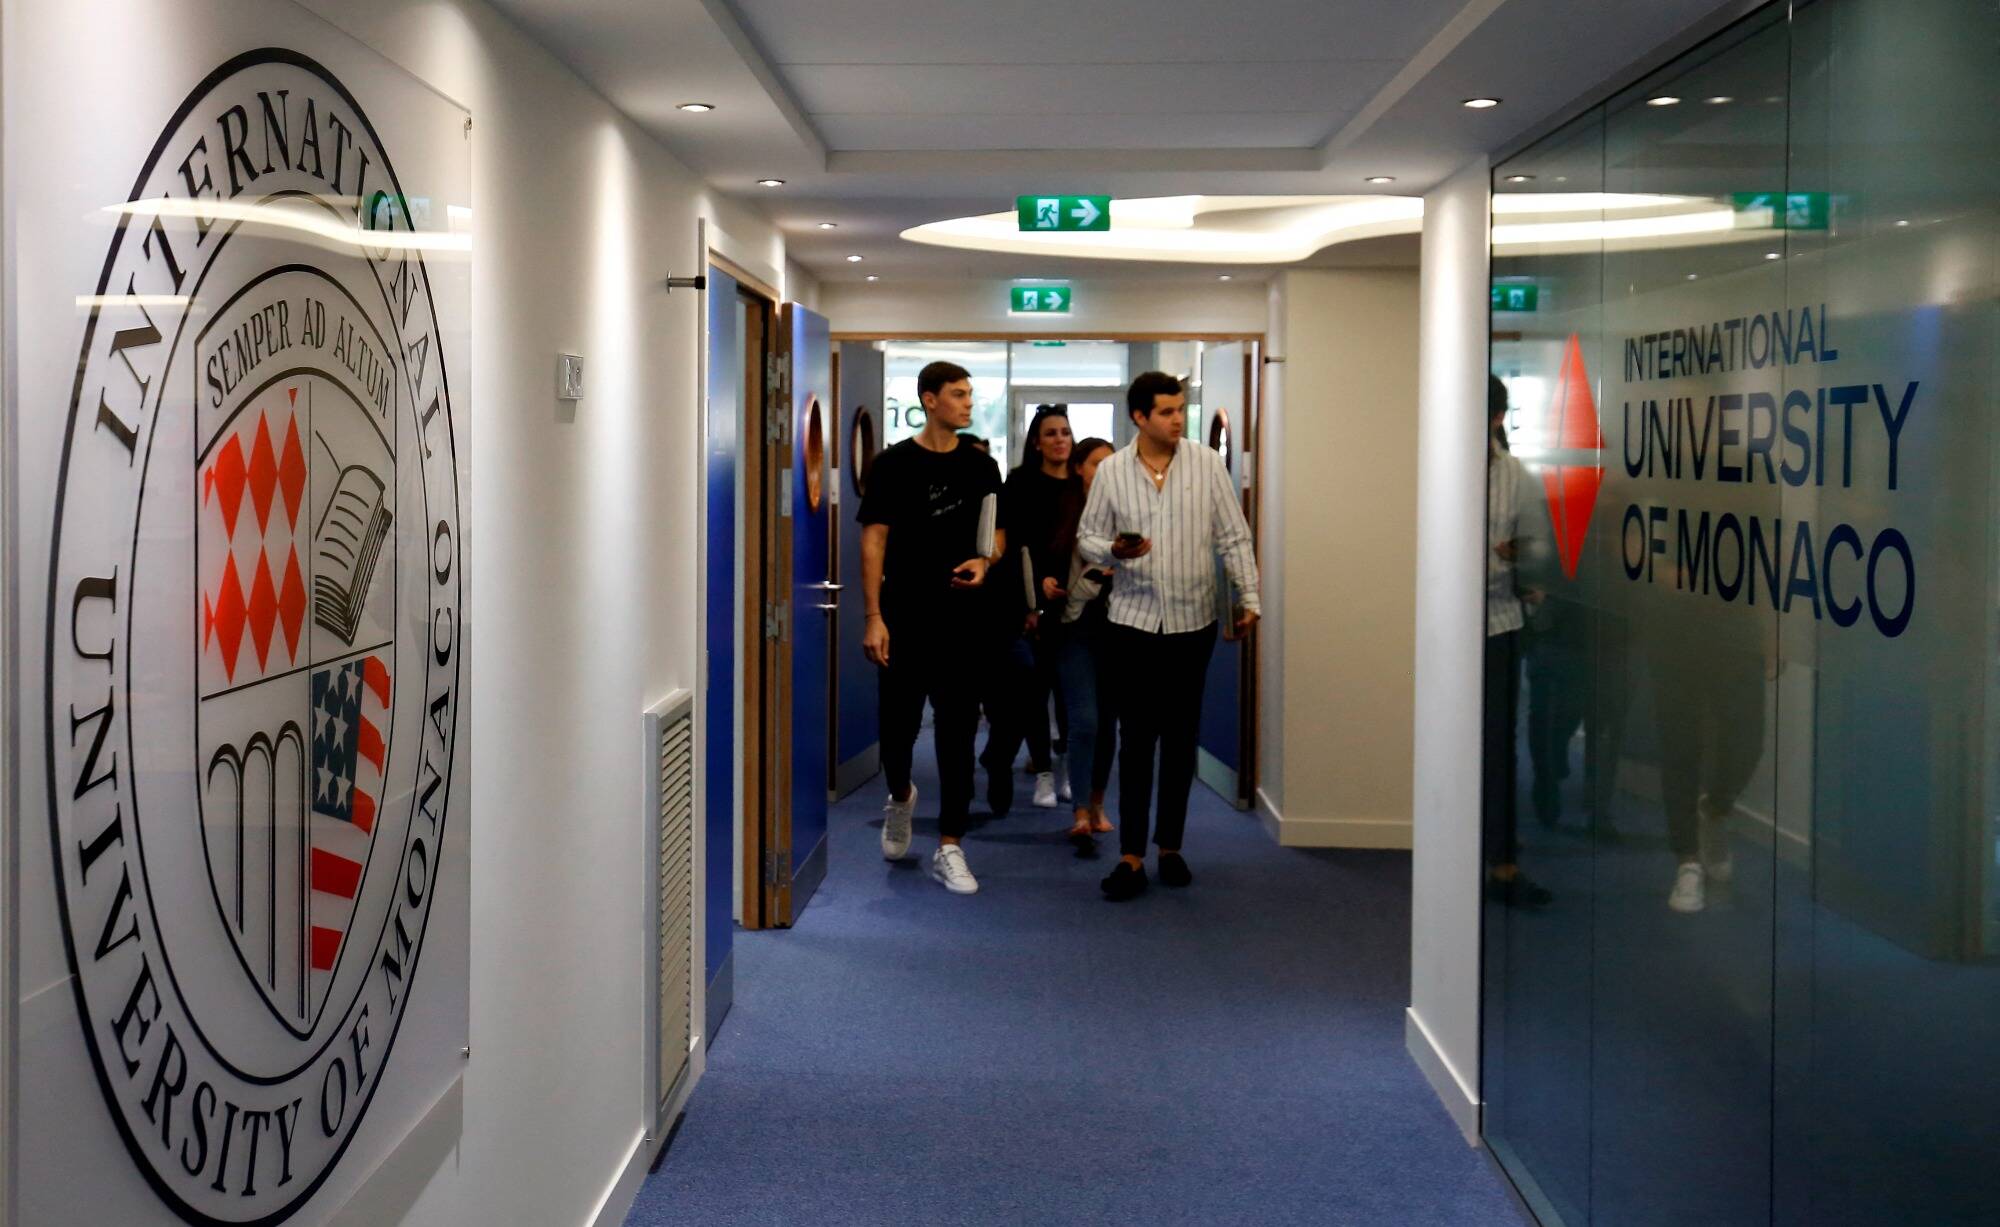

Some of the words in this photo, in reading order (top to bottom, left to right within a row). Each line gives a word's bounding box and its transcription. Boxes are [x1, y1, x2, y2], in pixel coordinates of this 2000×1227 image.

[95, 89, 442, 467] INTERNATIONAL
[207, 300, 292, 408] SEMPER
[301, 298, 326, 349] AD
[333, 315, 390, 419] ALTUM
[1624, 303, 1838, 382] INTERNATIONAL
[1624, 381, 1920, 490] UNIVERSITY
[1622, 504, 1668, 583] OF
[1677, 508, 1915, 638] MONACO
[71, 564, 303, 1196] UNIVERSITY
[321, 1003, 371, 1138] OF
[381, 519, 453, 1015] MONACO
